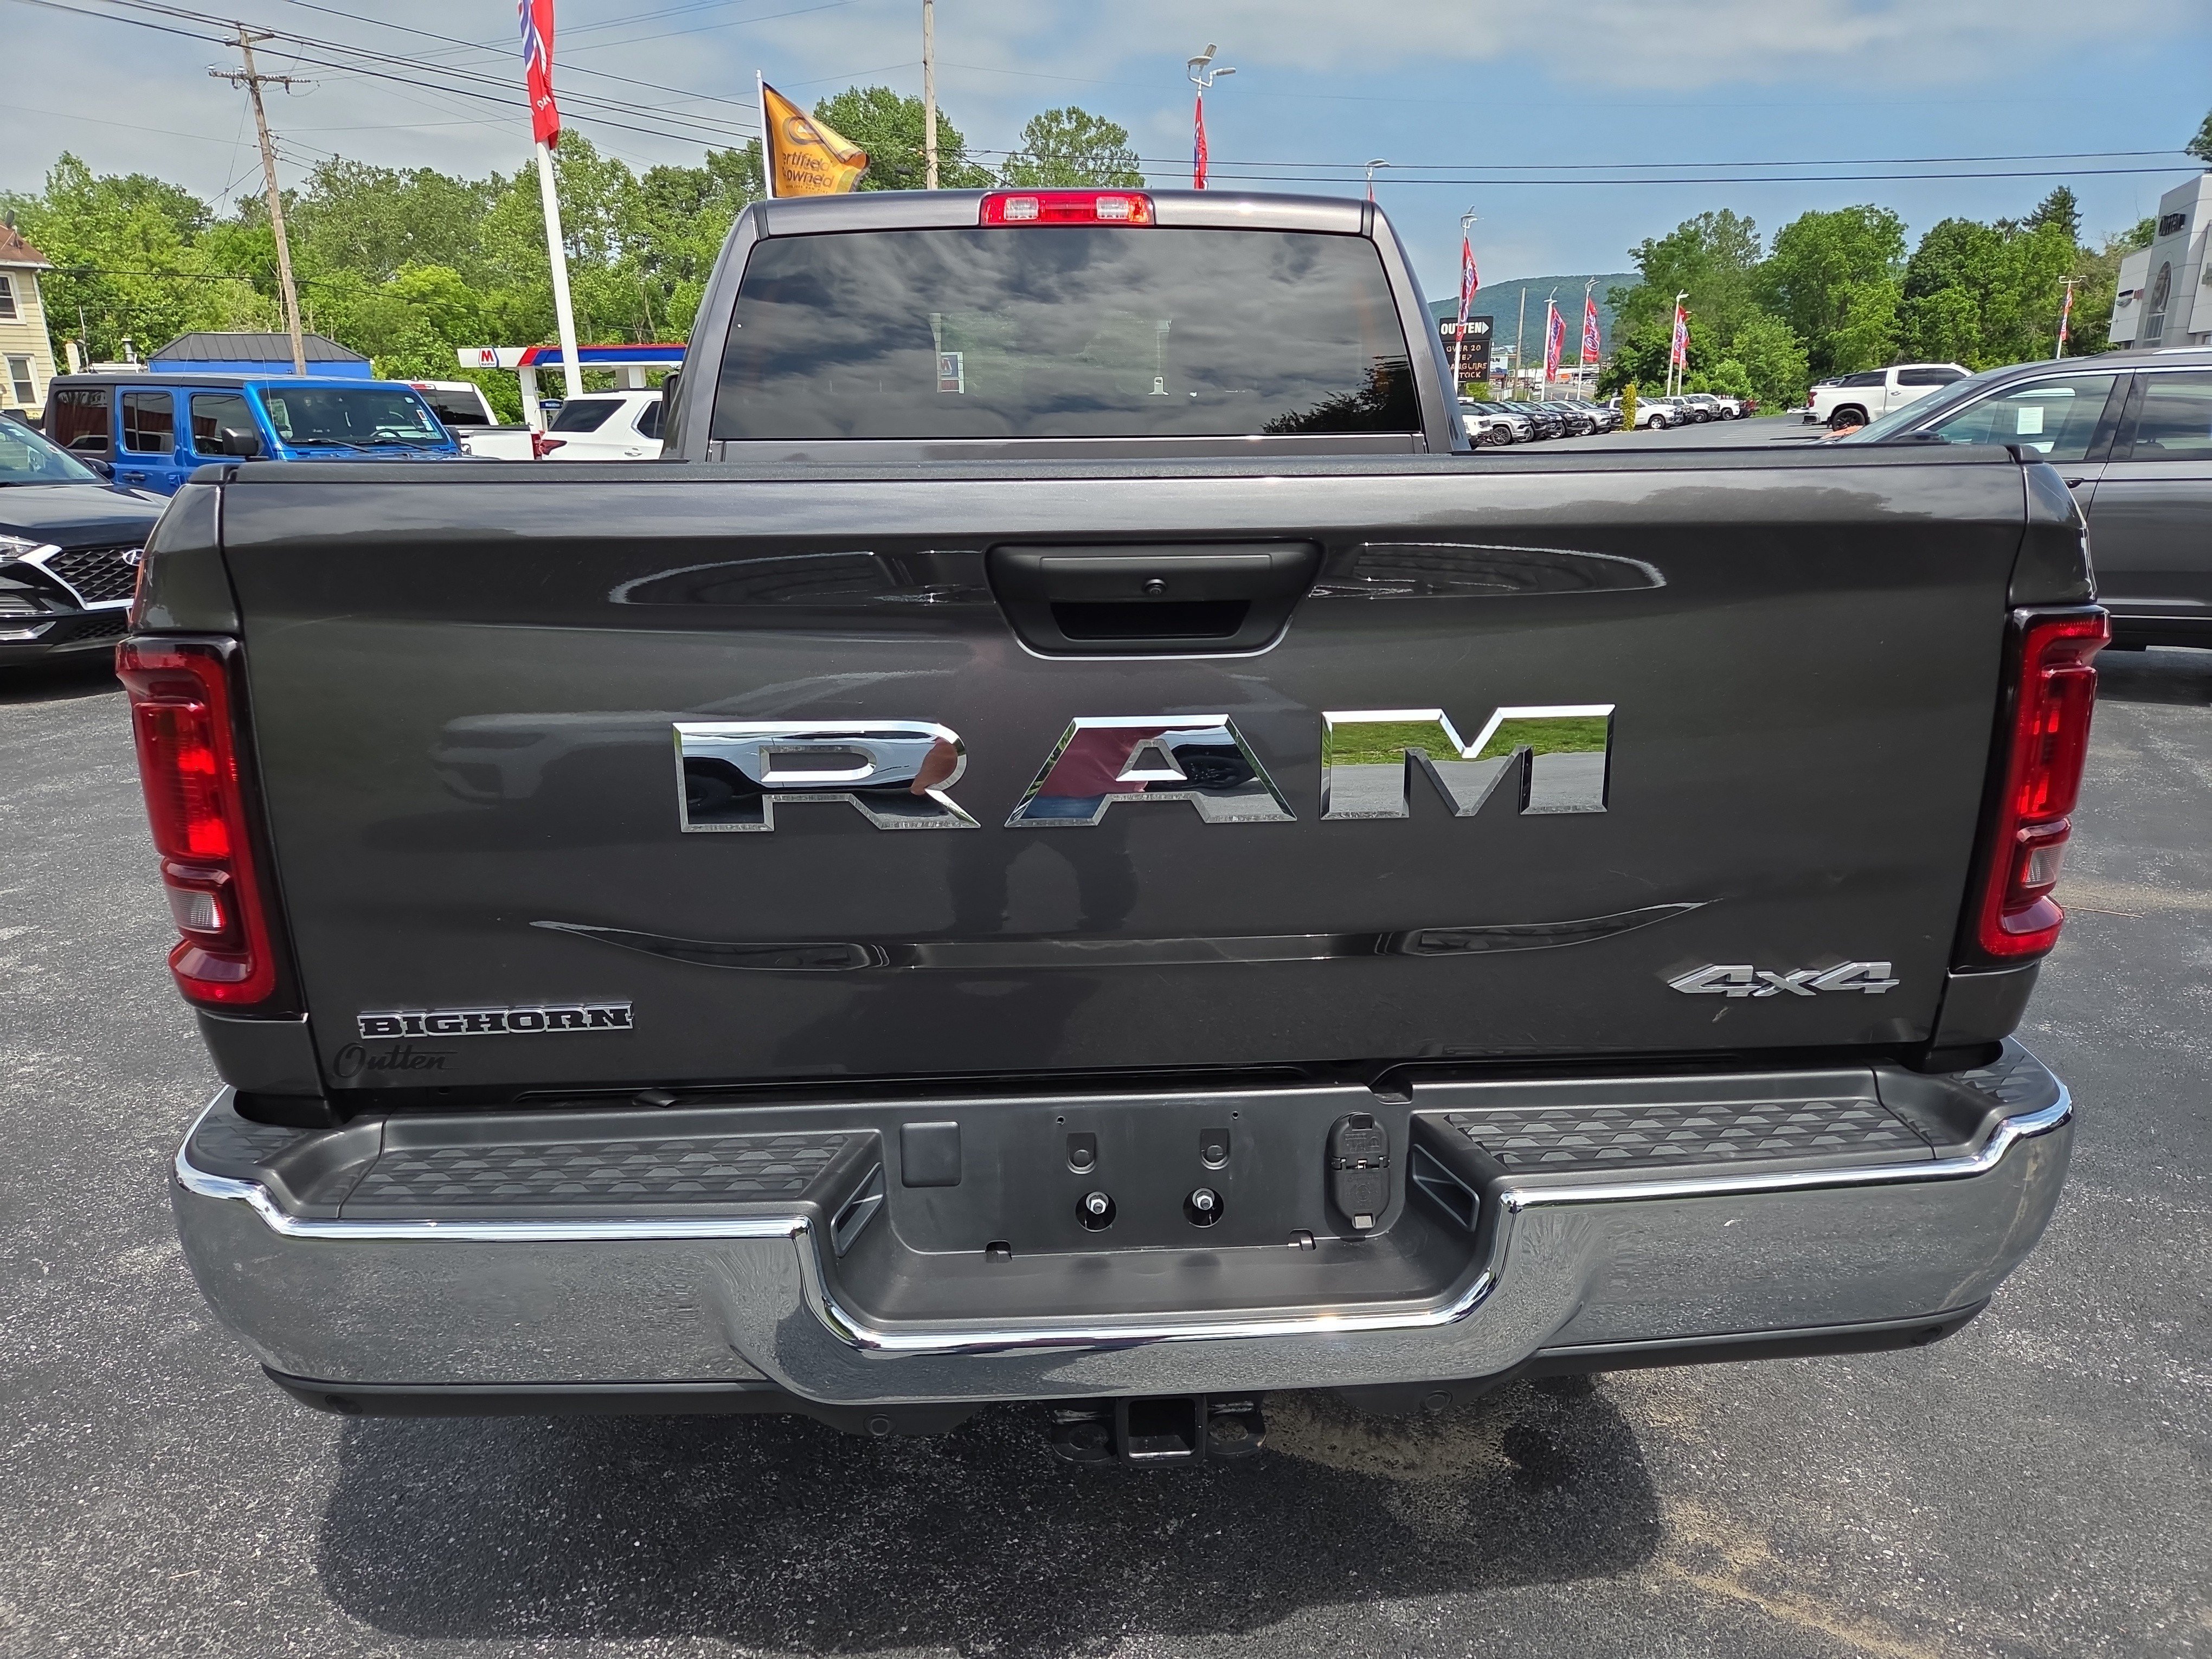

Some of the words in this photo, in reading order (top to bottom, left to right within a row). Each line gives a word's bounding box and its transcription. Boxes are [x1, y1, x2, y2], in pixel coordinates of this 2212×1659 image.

[481, 350, 494, 362] M
[1470, 344, 1481, 352] 20
[672, 704, 1616, 833] RAM
[1667, 961, 1900, 998] 4x4
[357, 1001, 634, 1039] BIGHORN
[333, 1042, 461, 1078] Outten
